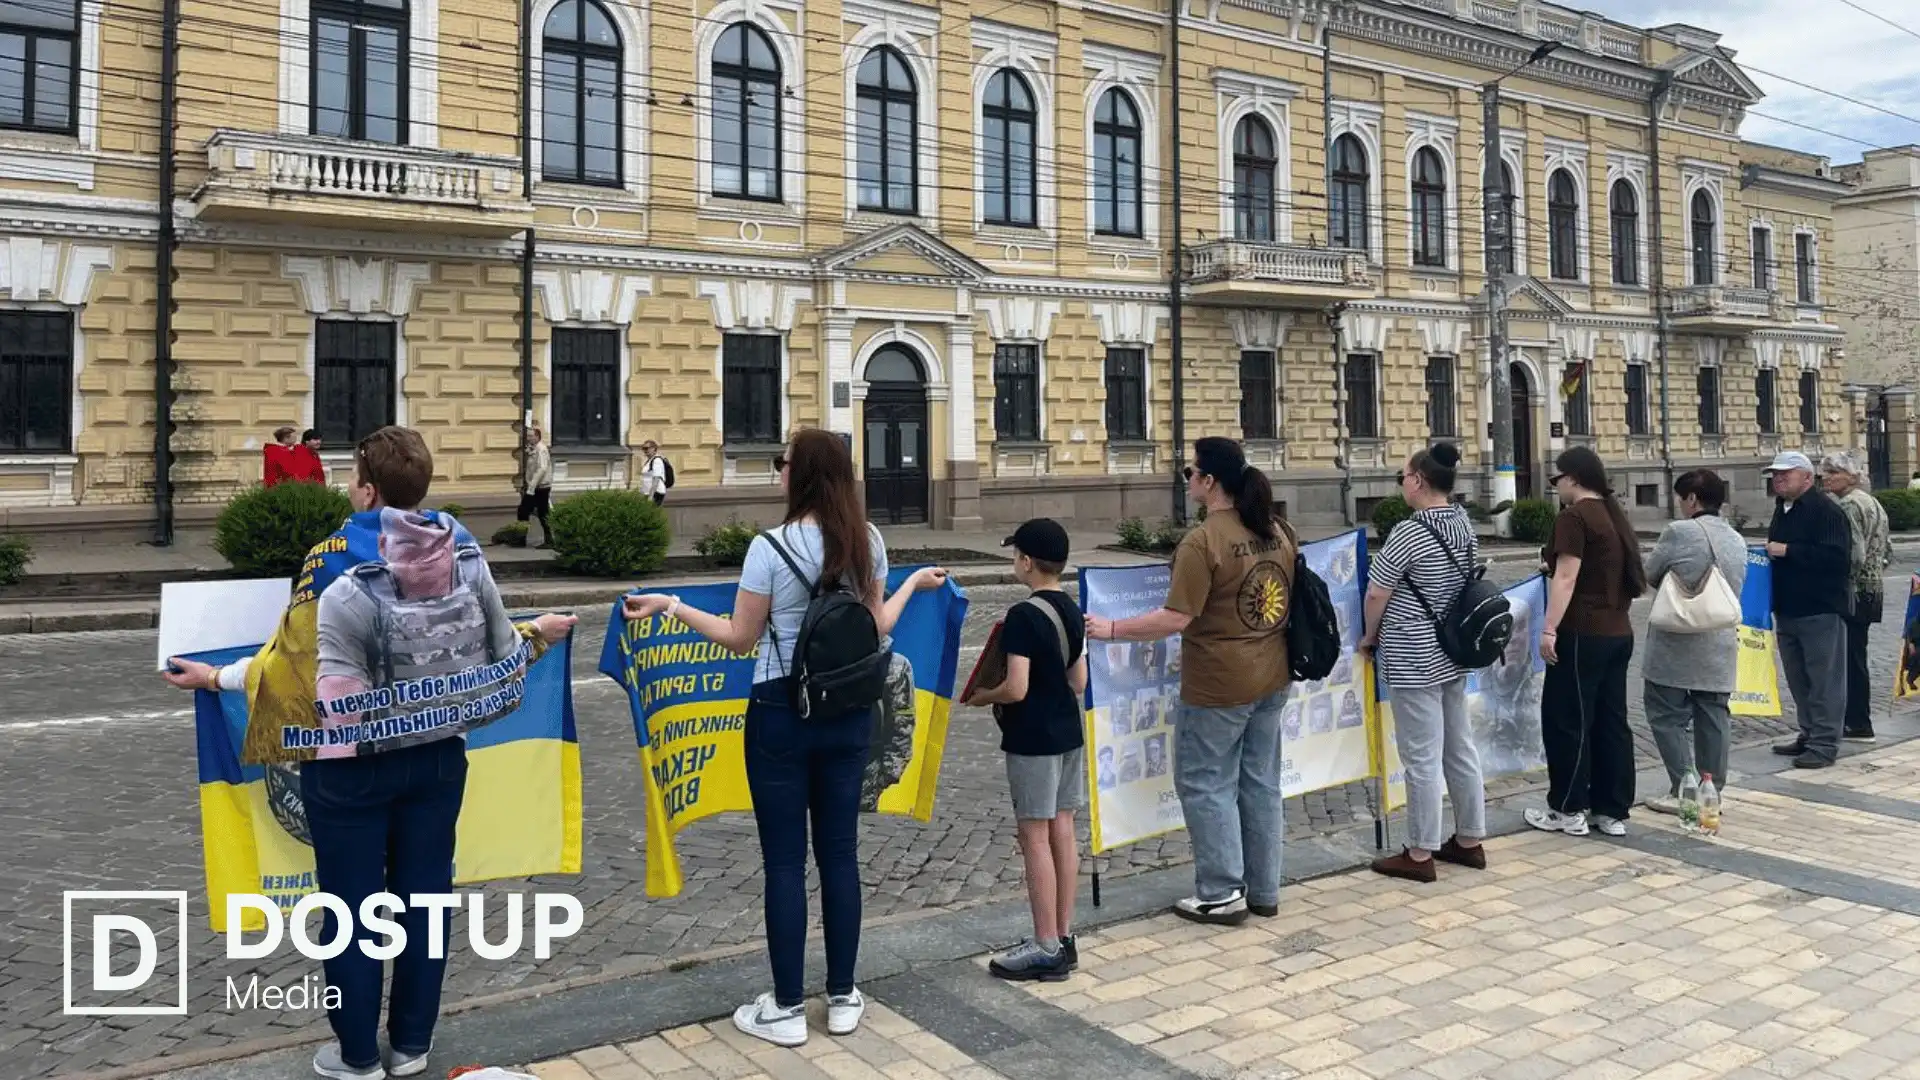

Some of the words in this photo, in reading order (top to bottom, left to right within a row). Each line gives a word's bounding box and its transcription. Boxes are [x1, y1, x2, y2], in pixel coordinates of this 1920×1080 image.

[314, 700, 329, 719] Я
[394, 676, 445, 705] Тебе
[282, 725, 324, 749] Моя
[463, 699, 482, 720] за
